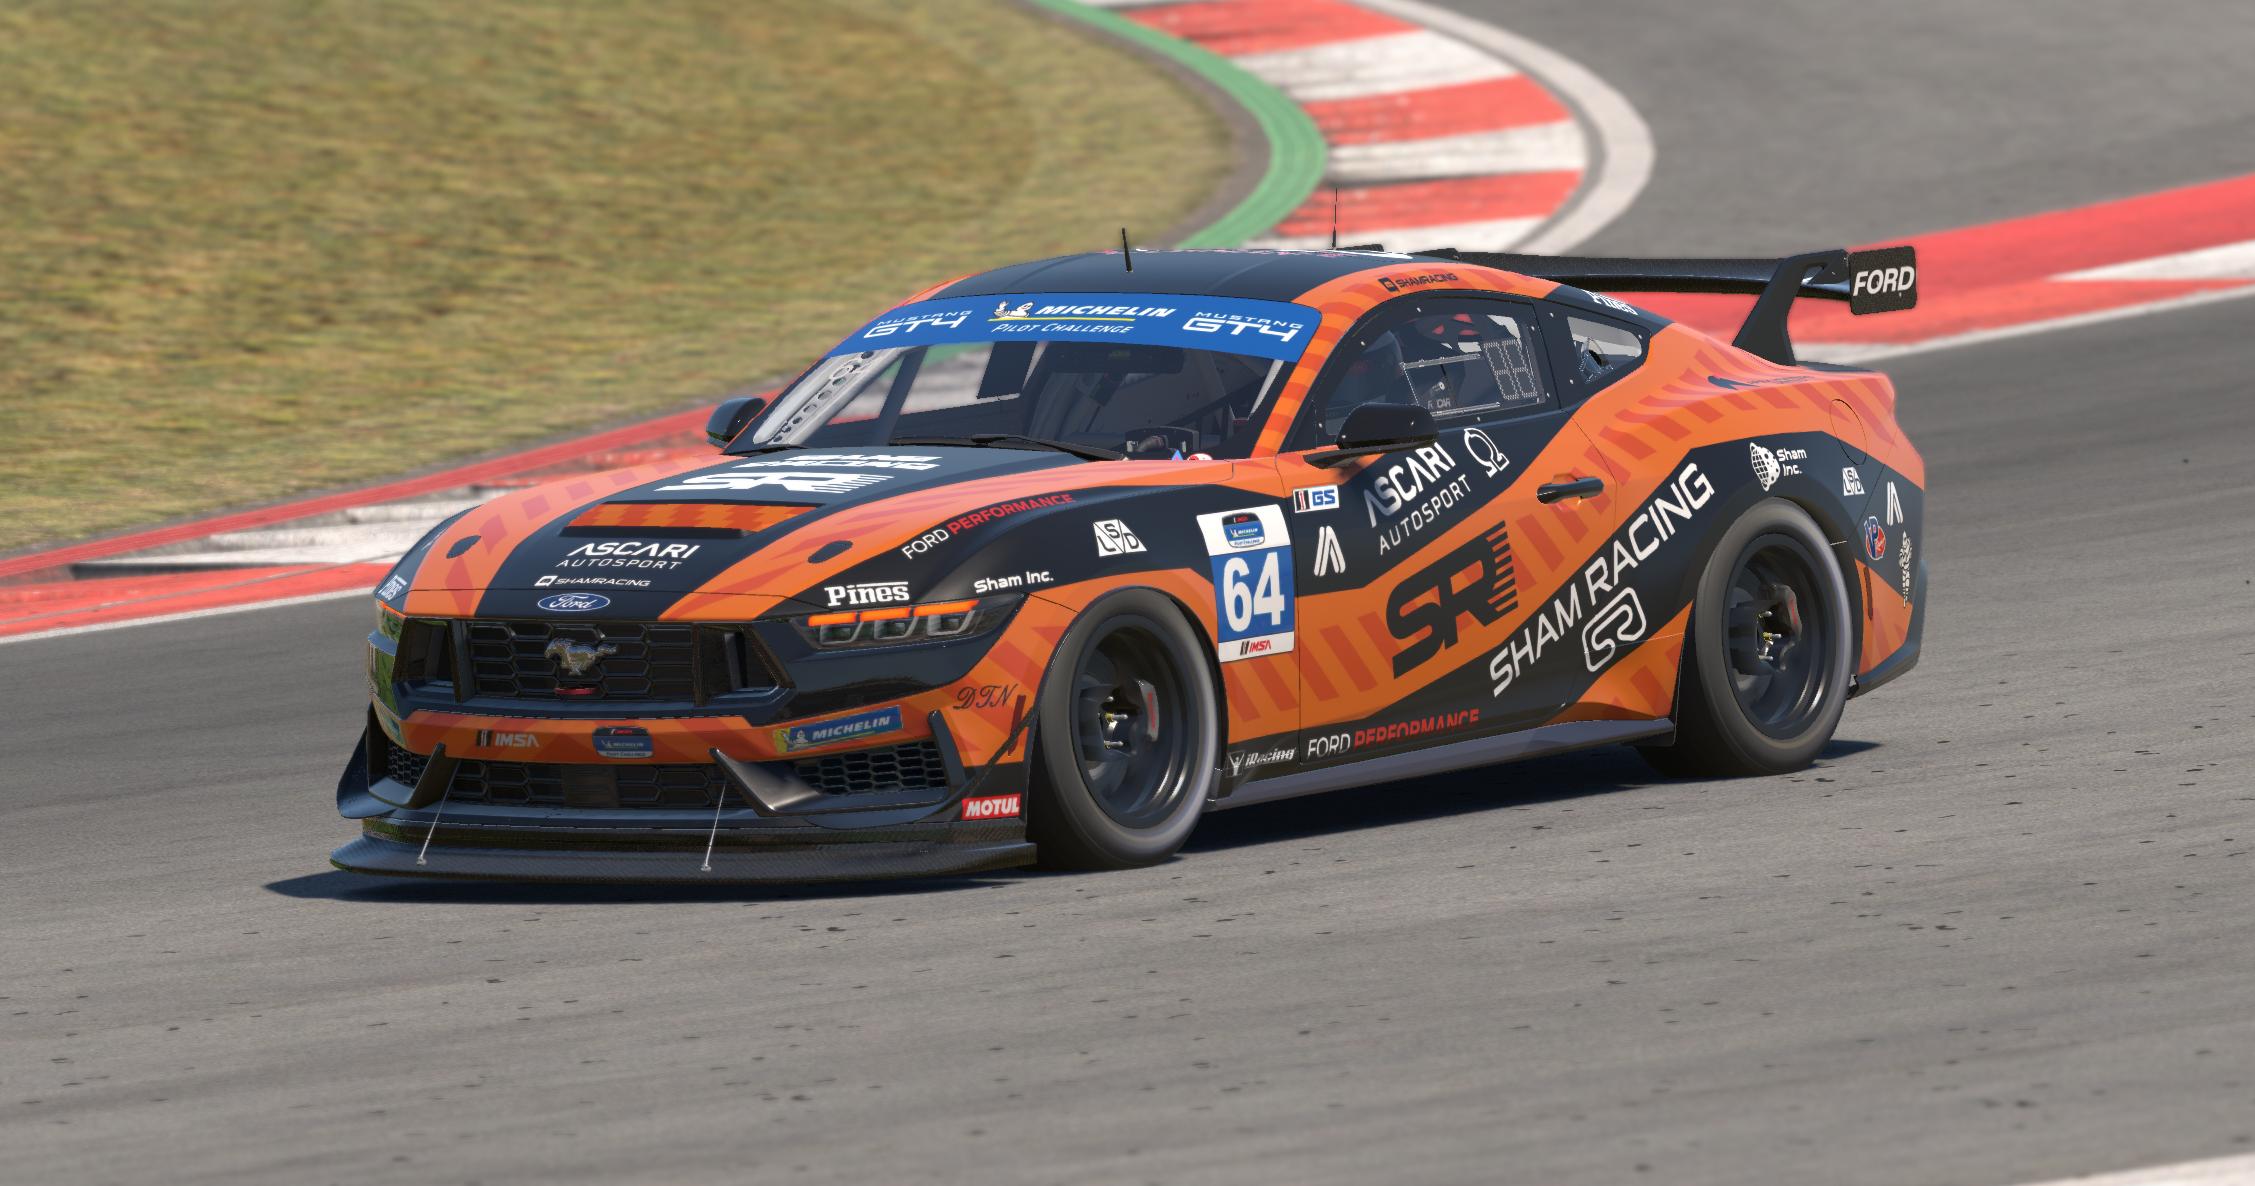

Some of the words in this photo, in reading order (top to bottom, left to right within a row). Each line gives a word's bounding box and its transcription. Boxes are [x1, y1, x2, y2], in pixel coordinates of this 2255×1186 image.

[1853, 266, 1915, 296] FORD
[876, 310, 972, 326] MUSTANG
[1034, 305, 1177, 318] MICHELIN
[1195, 311, 1304, 329] MUSTANG
[863, 316, 965, 339] GT4
[991, 323, 1038, 334] PILOT
[1041, 323, 1134, 334] CHALLENGE
[1182, 317, 1299, 342] GT4
[1777, 448, 1807, 461] Sham
[1783, 464, 1803, 476] Inc.
[1363, 441, 1456, 528] ASCARI
[1312, 489, 1336, 507] GS
[1380, 474, 1471, 556] AUTOSPORT
[901, 528, 950, 560] FORD
[947, 494, 1073, 535] PERFORMANCE
[567, 542, 701, 559] ASCARI
[555, 559, 682, 570] AUTOSPORT
[554, 578, 651, 587] SHAMRACING
[973, 575, 1022, 594] Sham
[1026, 571, 1054, 586] Inc.
[1489, 584, 1583, 698] SHAM
[1584, 462, 1715, 606] RACING
[549, 594, 598, 609] Ford
[824, 582, 910, 607] Pines
[1223, 552, 1286, 633] 64
[1249, 639, 1272, 652] IMSA
[812, 716, 891, 740] MICHELIN
[495, 732, 540, 748] IMSA
[1306, 733, 1351, 760] FORD
[1245, 747, 1297, 767] iRacing
[966, 797, 1020, 817] MOTUL
